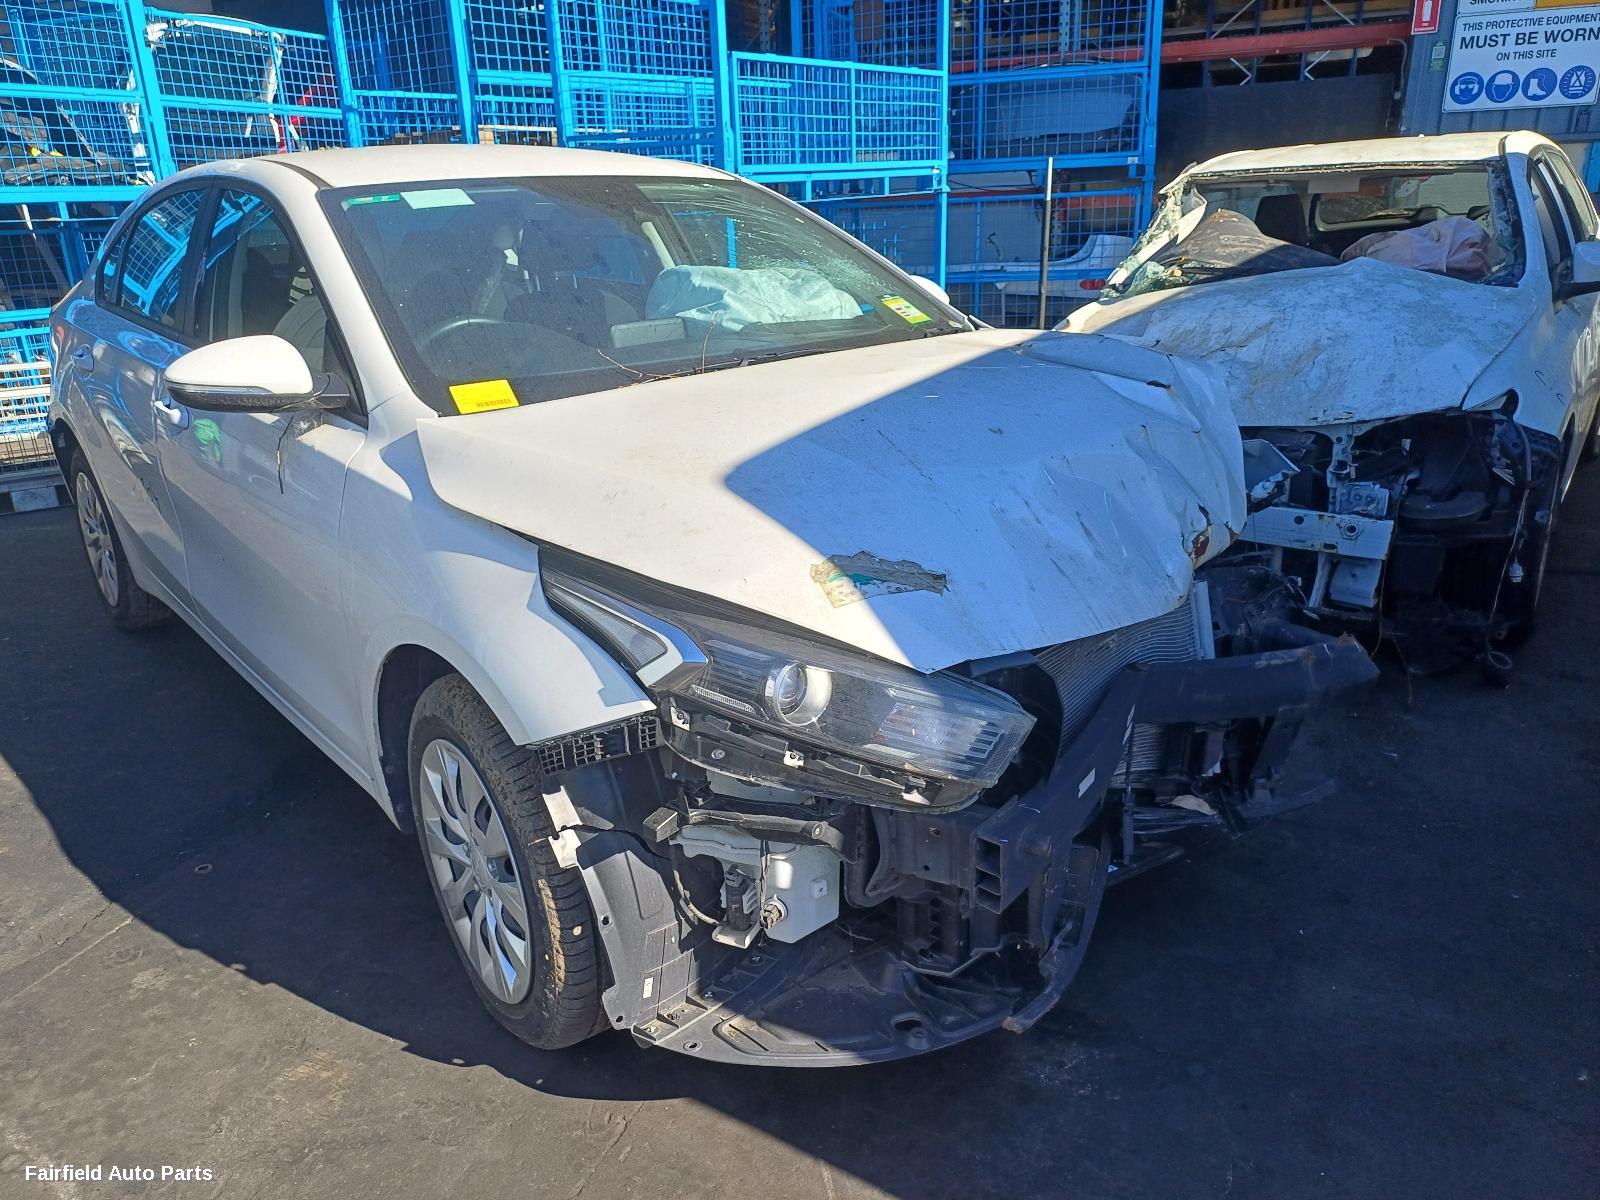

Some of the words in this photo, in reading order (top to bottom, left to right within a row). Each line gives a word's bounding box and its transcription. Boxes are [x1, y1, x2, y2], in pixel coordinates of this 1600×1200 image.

[1463, 22, 1484, 32] THIS
[1486, 17, 1544, 30] PROTECTIVE
[1460, 33, 1511, 49] MUST
[1515, 31, 1539, 46] BE
[1544, 26, 1600, 44] WORN
[1496, 52, 1510, 61] ON
[1513, 50, 1534, 60] THIS
[1536, 48, 1557, 58] SITE
